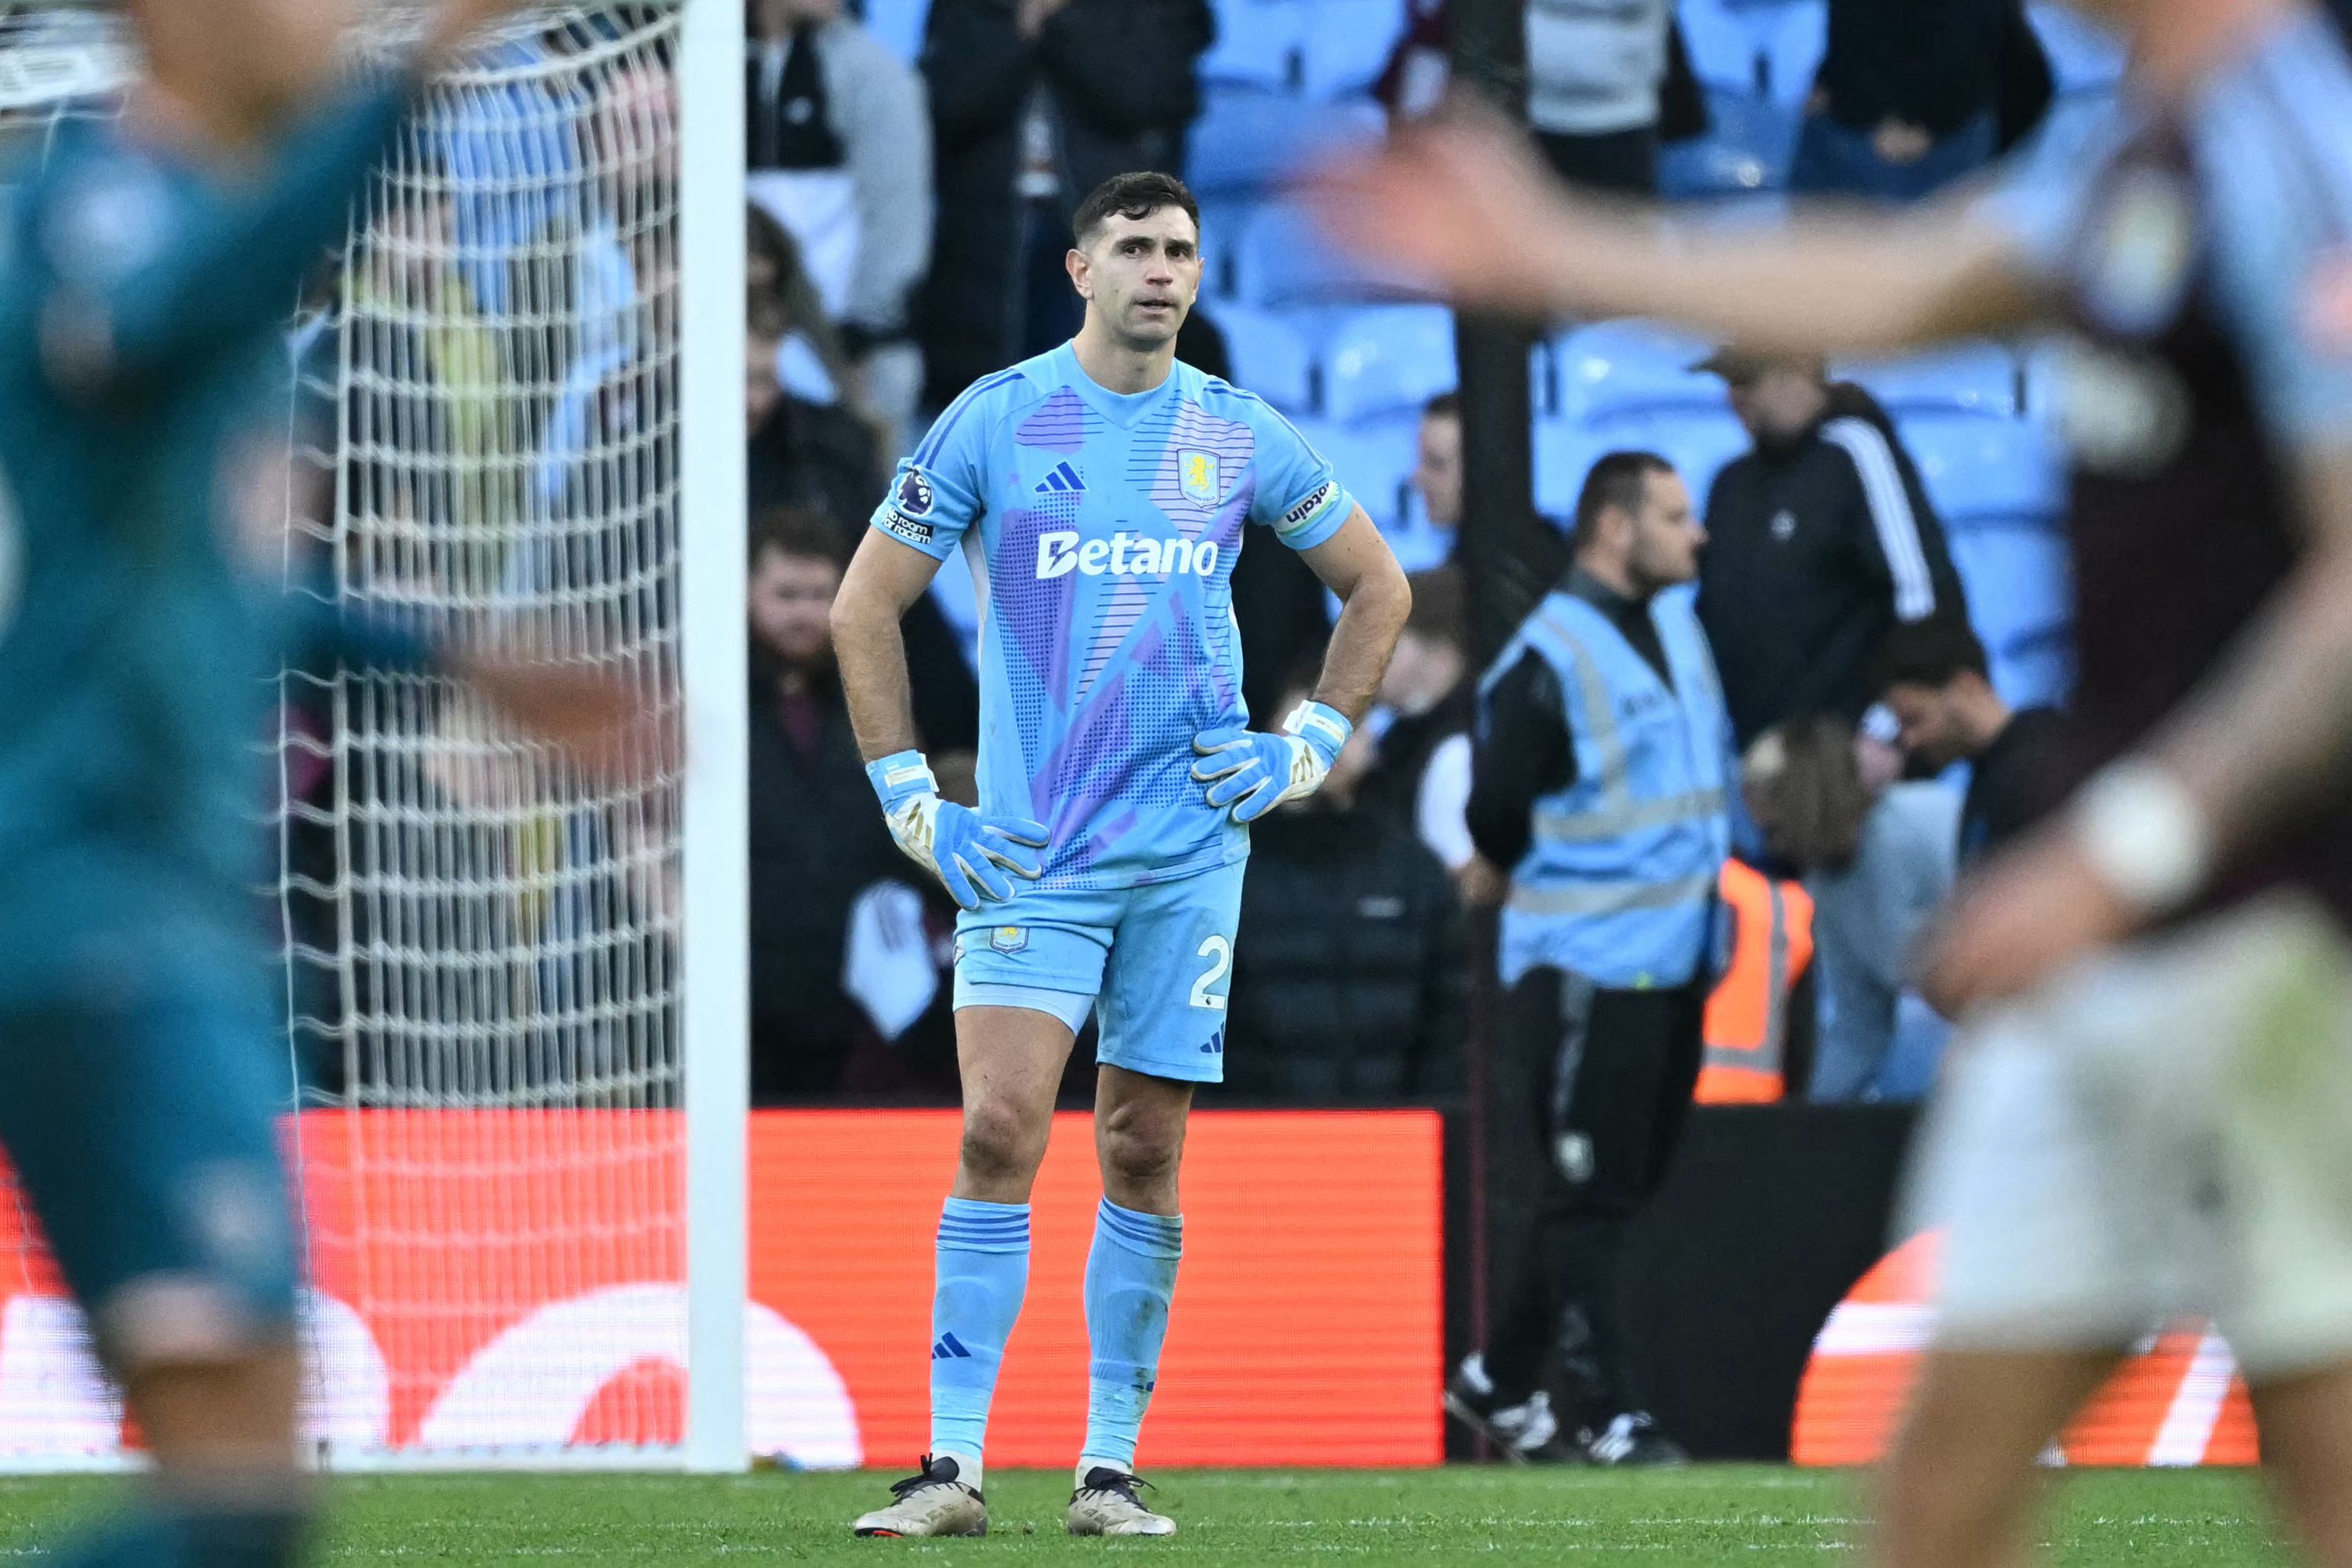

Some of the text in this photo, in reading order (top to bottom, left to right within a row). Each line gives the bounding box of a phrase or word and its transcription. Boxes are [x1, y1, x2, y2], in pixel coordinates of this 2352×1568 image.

[1286, 483, 1329, 523] ptain
[893, 524, 931, 544] racism
[897, 516, 928, 534] room
[1036, 531, 1219, 579] Betano
[1189, 935, 1230, 1009] 2
